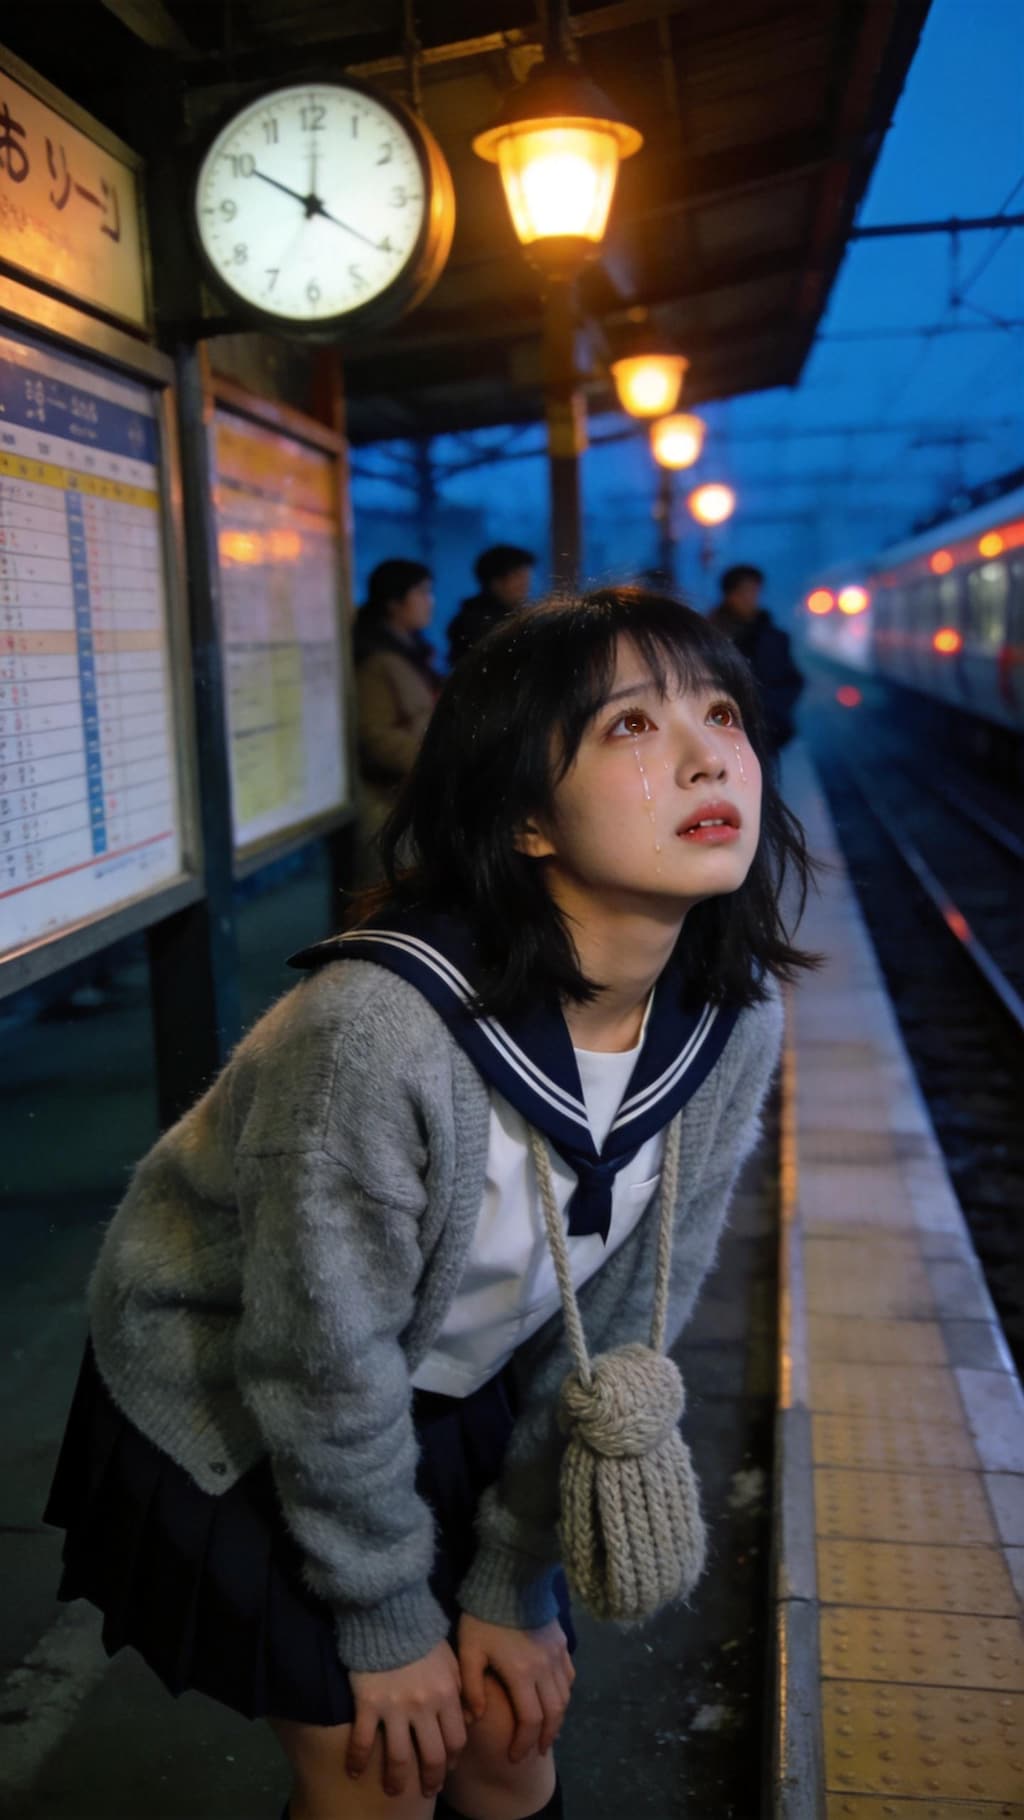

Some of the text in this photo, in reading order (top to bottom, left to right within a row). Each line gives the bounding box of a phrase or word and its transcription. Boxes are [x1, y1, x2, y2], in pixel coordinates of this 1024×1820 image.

[299, 105, 327, 131] 12
[350, 114, 359, 140] 1
[262, 118, 280, 144] 11
[228, 153, 256, 178] 10
[375, 143, 393, 166] 2
[390, 186, 408, 209] 3
[219, 199, 238, 223] 9
[233, 242, 249, 265] 8
[379, 236, 393, 254] 4
[264, 267, 281, 293] 7
[348, 264, 369, 288] 5
[306, 278, 321, 303] 6
